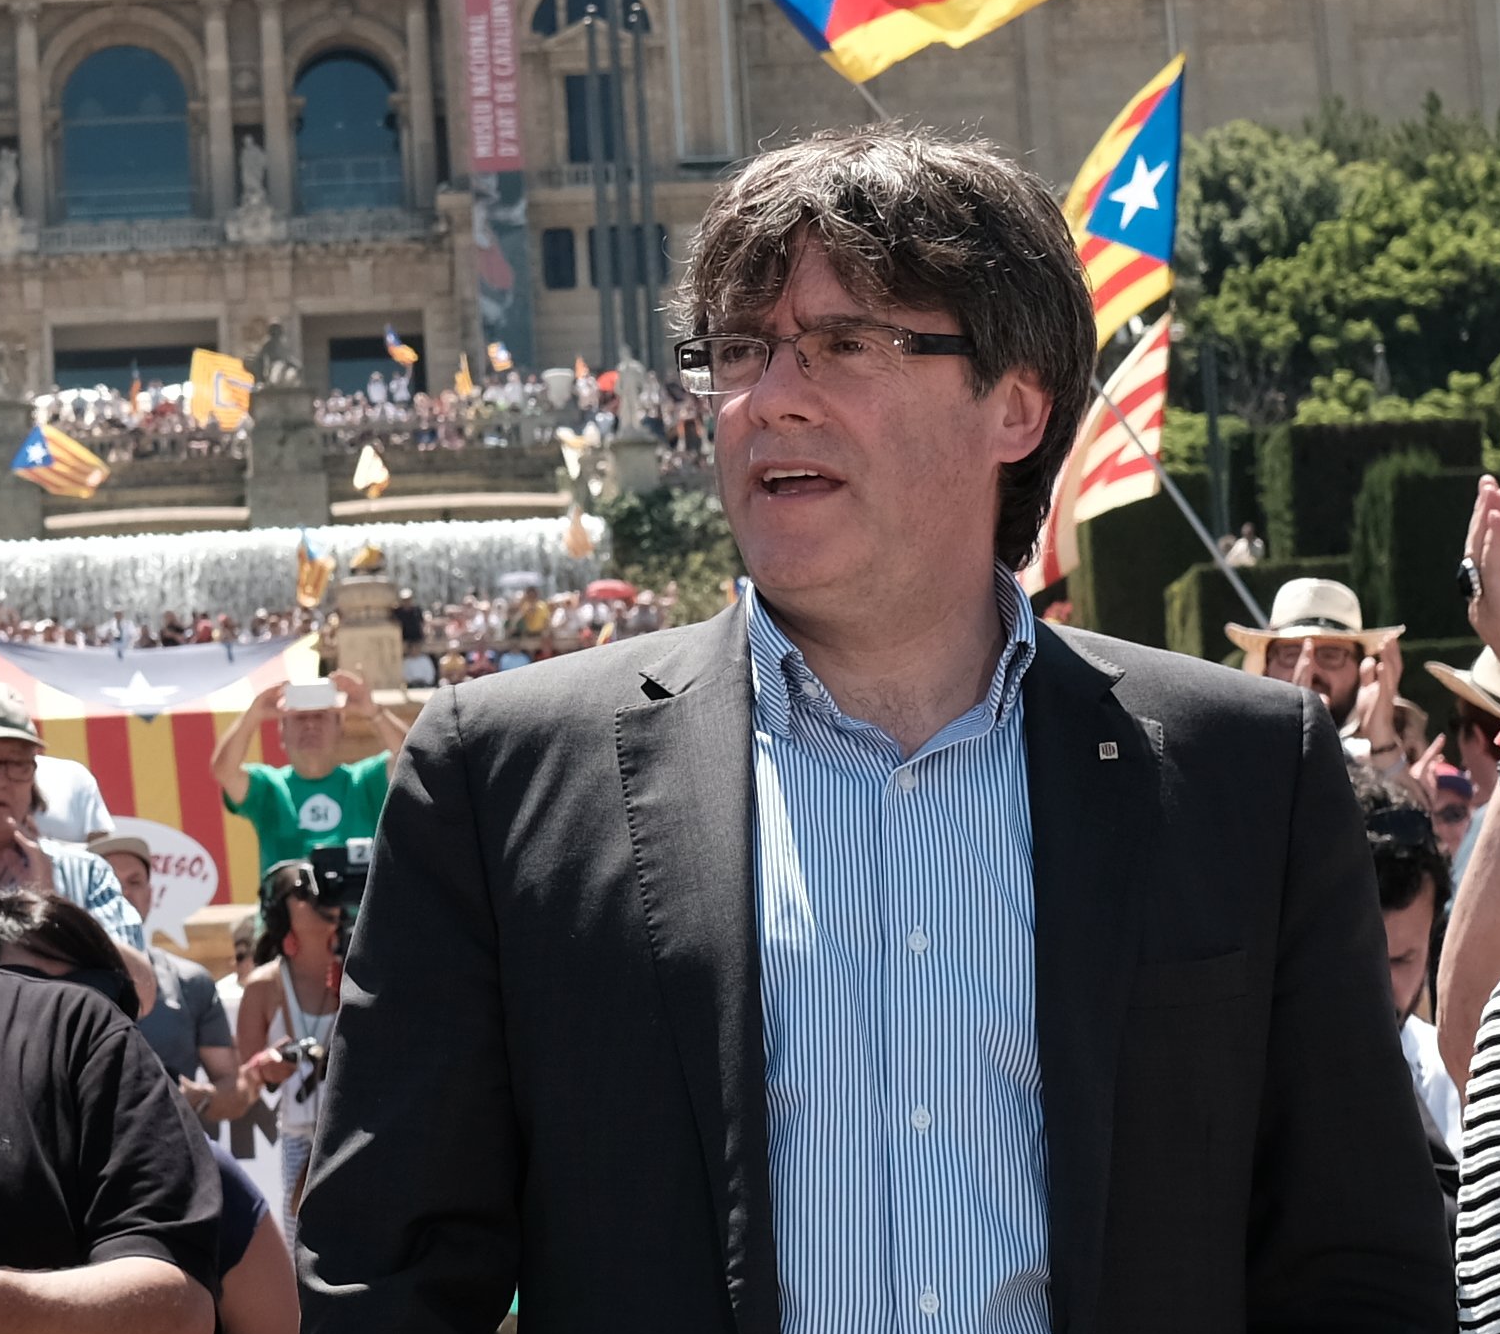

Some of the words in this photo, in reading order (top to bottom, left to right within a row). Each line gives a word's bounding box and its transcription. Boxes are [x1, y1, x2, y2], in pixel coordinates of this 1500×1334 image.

[468, 15, 491, 97] NACIONAL
[493, 81, 516, 103] DE
[472, 100, 494, 158] MUSEU
